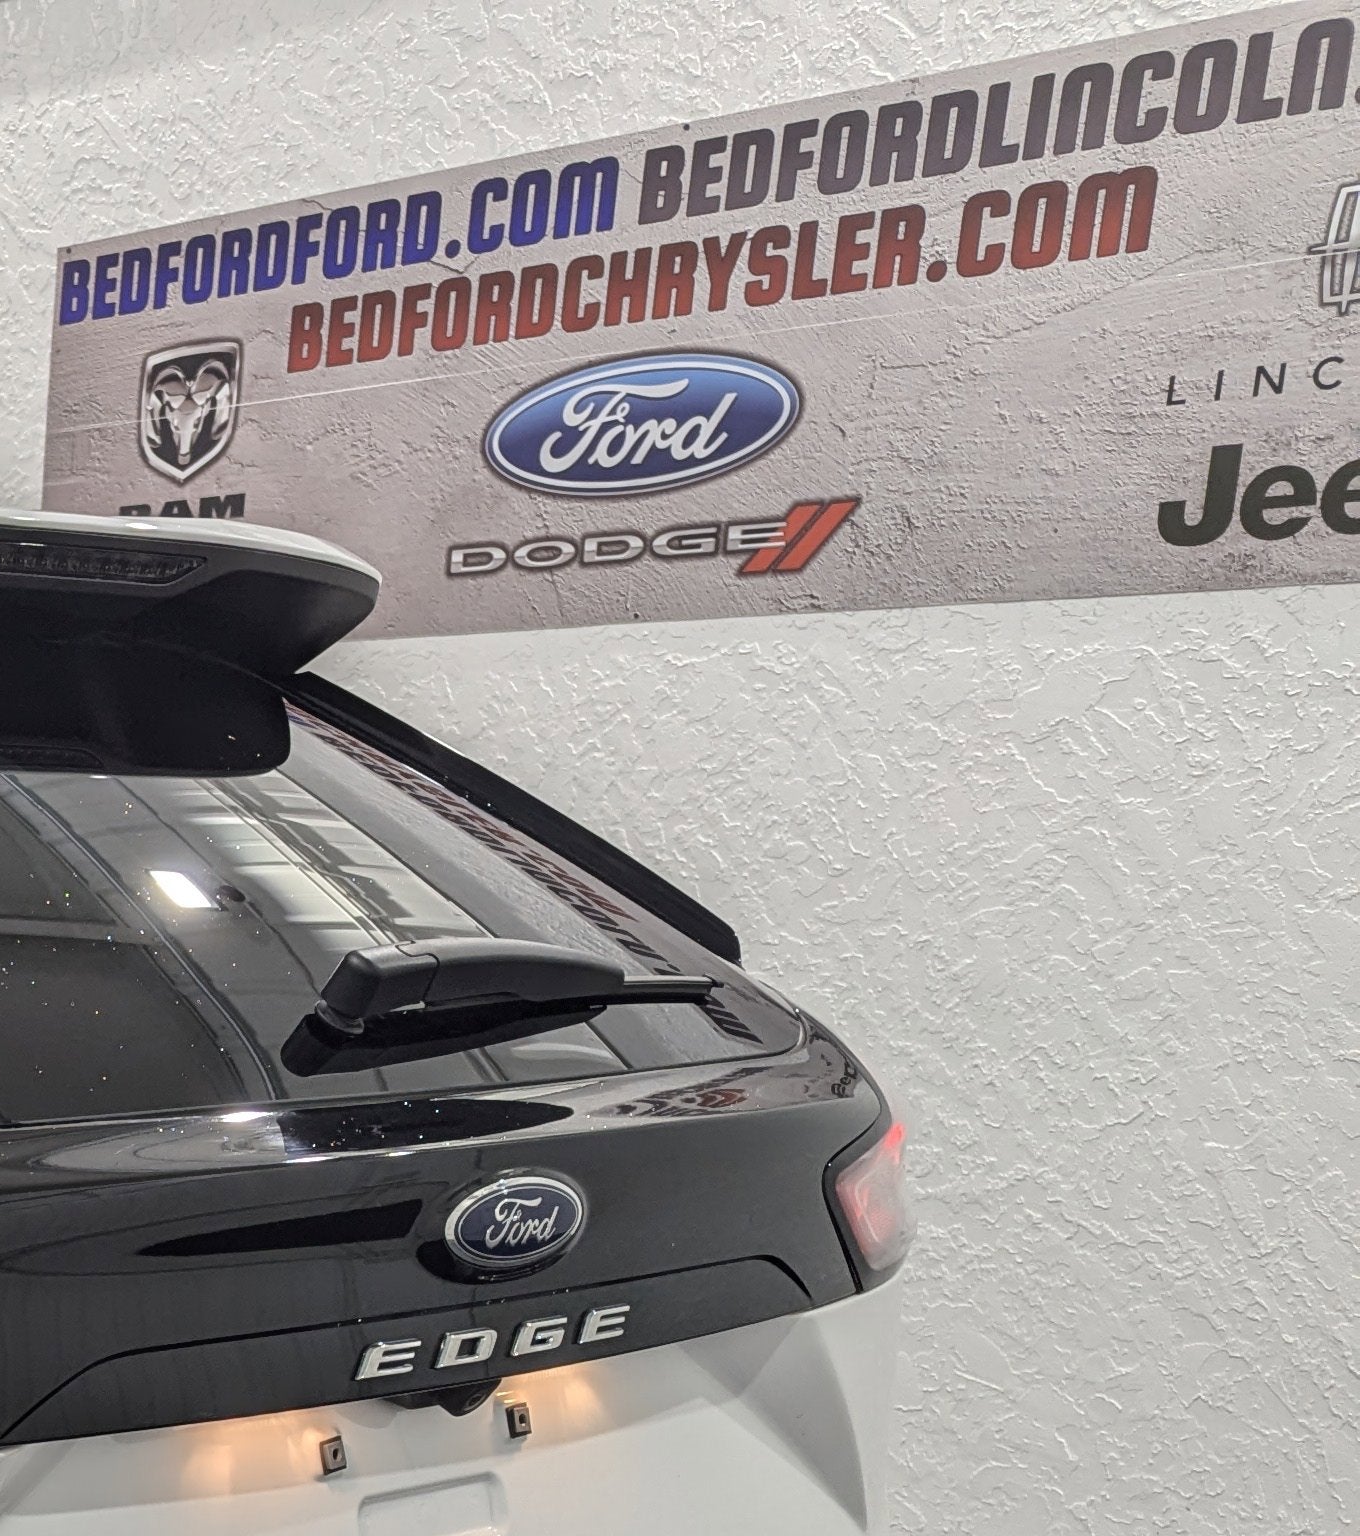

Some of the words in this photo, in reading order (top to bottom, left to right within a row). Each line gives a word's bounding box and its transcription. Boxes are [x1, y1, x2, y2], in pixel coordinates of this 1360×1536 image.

[59, 157, 620, 325] BEDFORDFORD.COM
[287, 165, 1160, 373] BEDFORDCHRYSLER.COM
[538, 382, 725, 472] Ford
[447, 520, 788, 577] DODGE
[485, 1197, 558, 1248] Ford
[354, 1305, 631, 1381] EDGE
